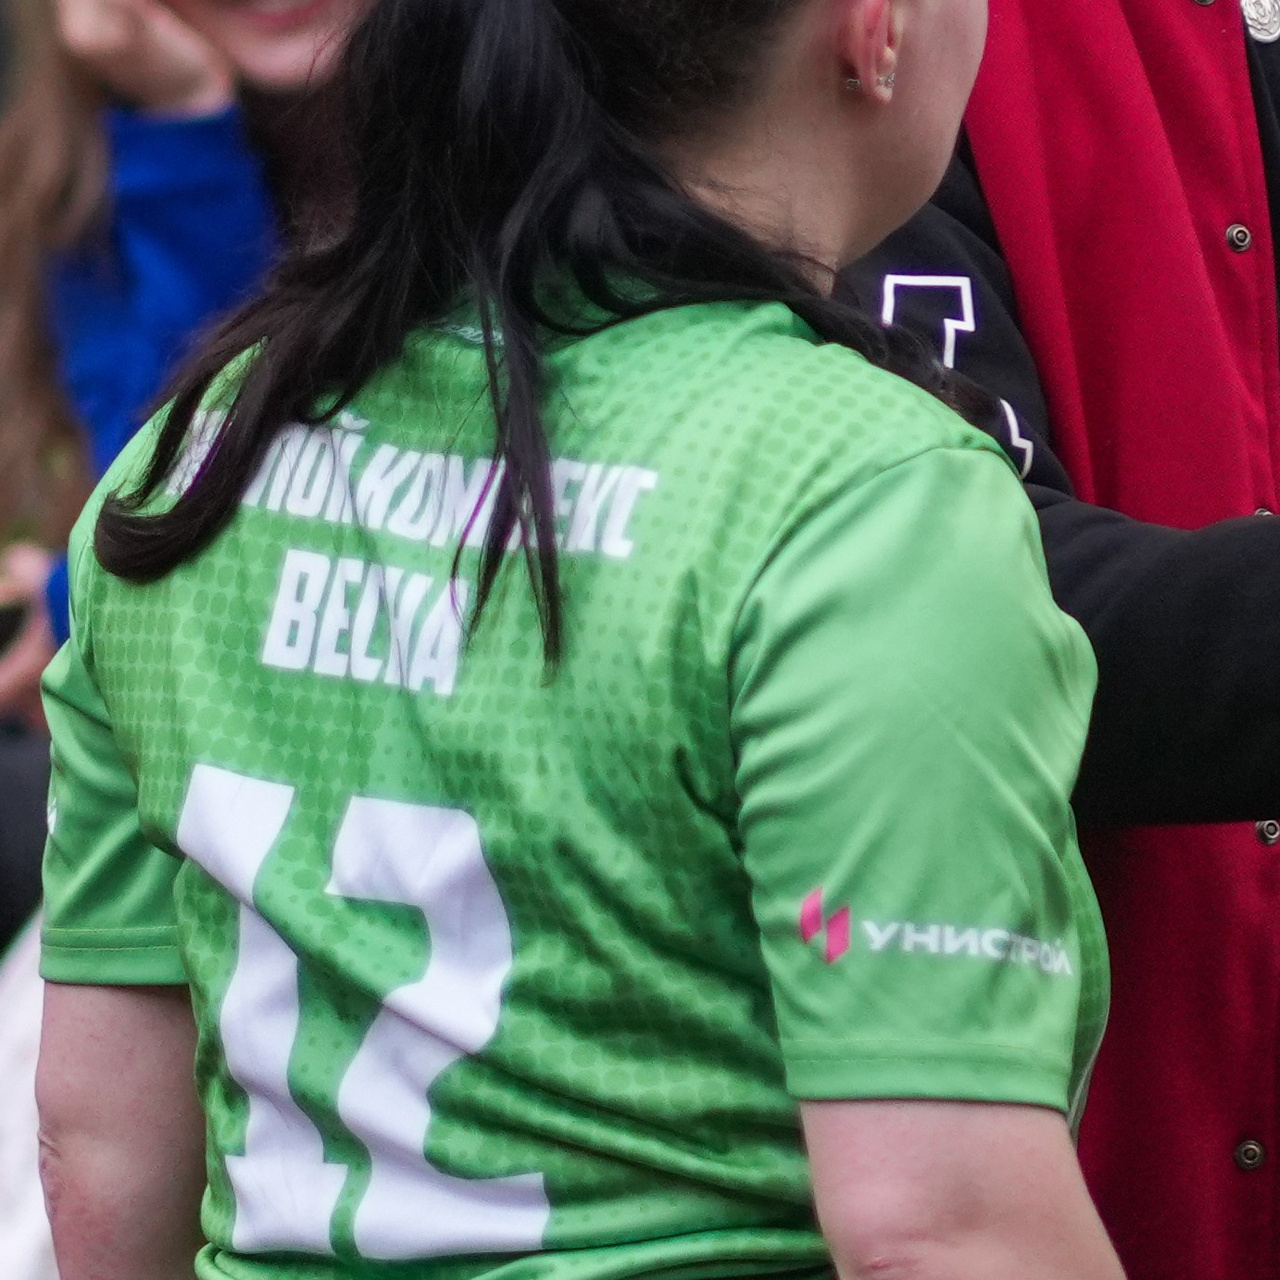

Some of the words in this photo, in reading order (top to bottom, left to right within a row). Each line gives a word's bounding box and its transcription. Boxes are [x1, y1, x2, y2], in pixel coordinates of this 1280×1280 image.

[165, 409, 369, 524] ЛОЙ
[356, 442, 659, 558] КОМЕКС
[176, 762, 550, 1261] 12
[860, 919, 1074, 977] УНИСТРОЙ
